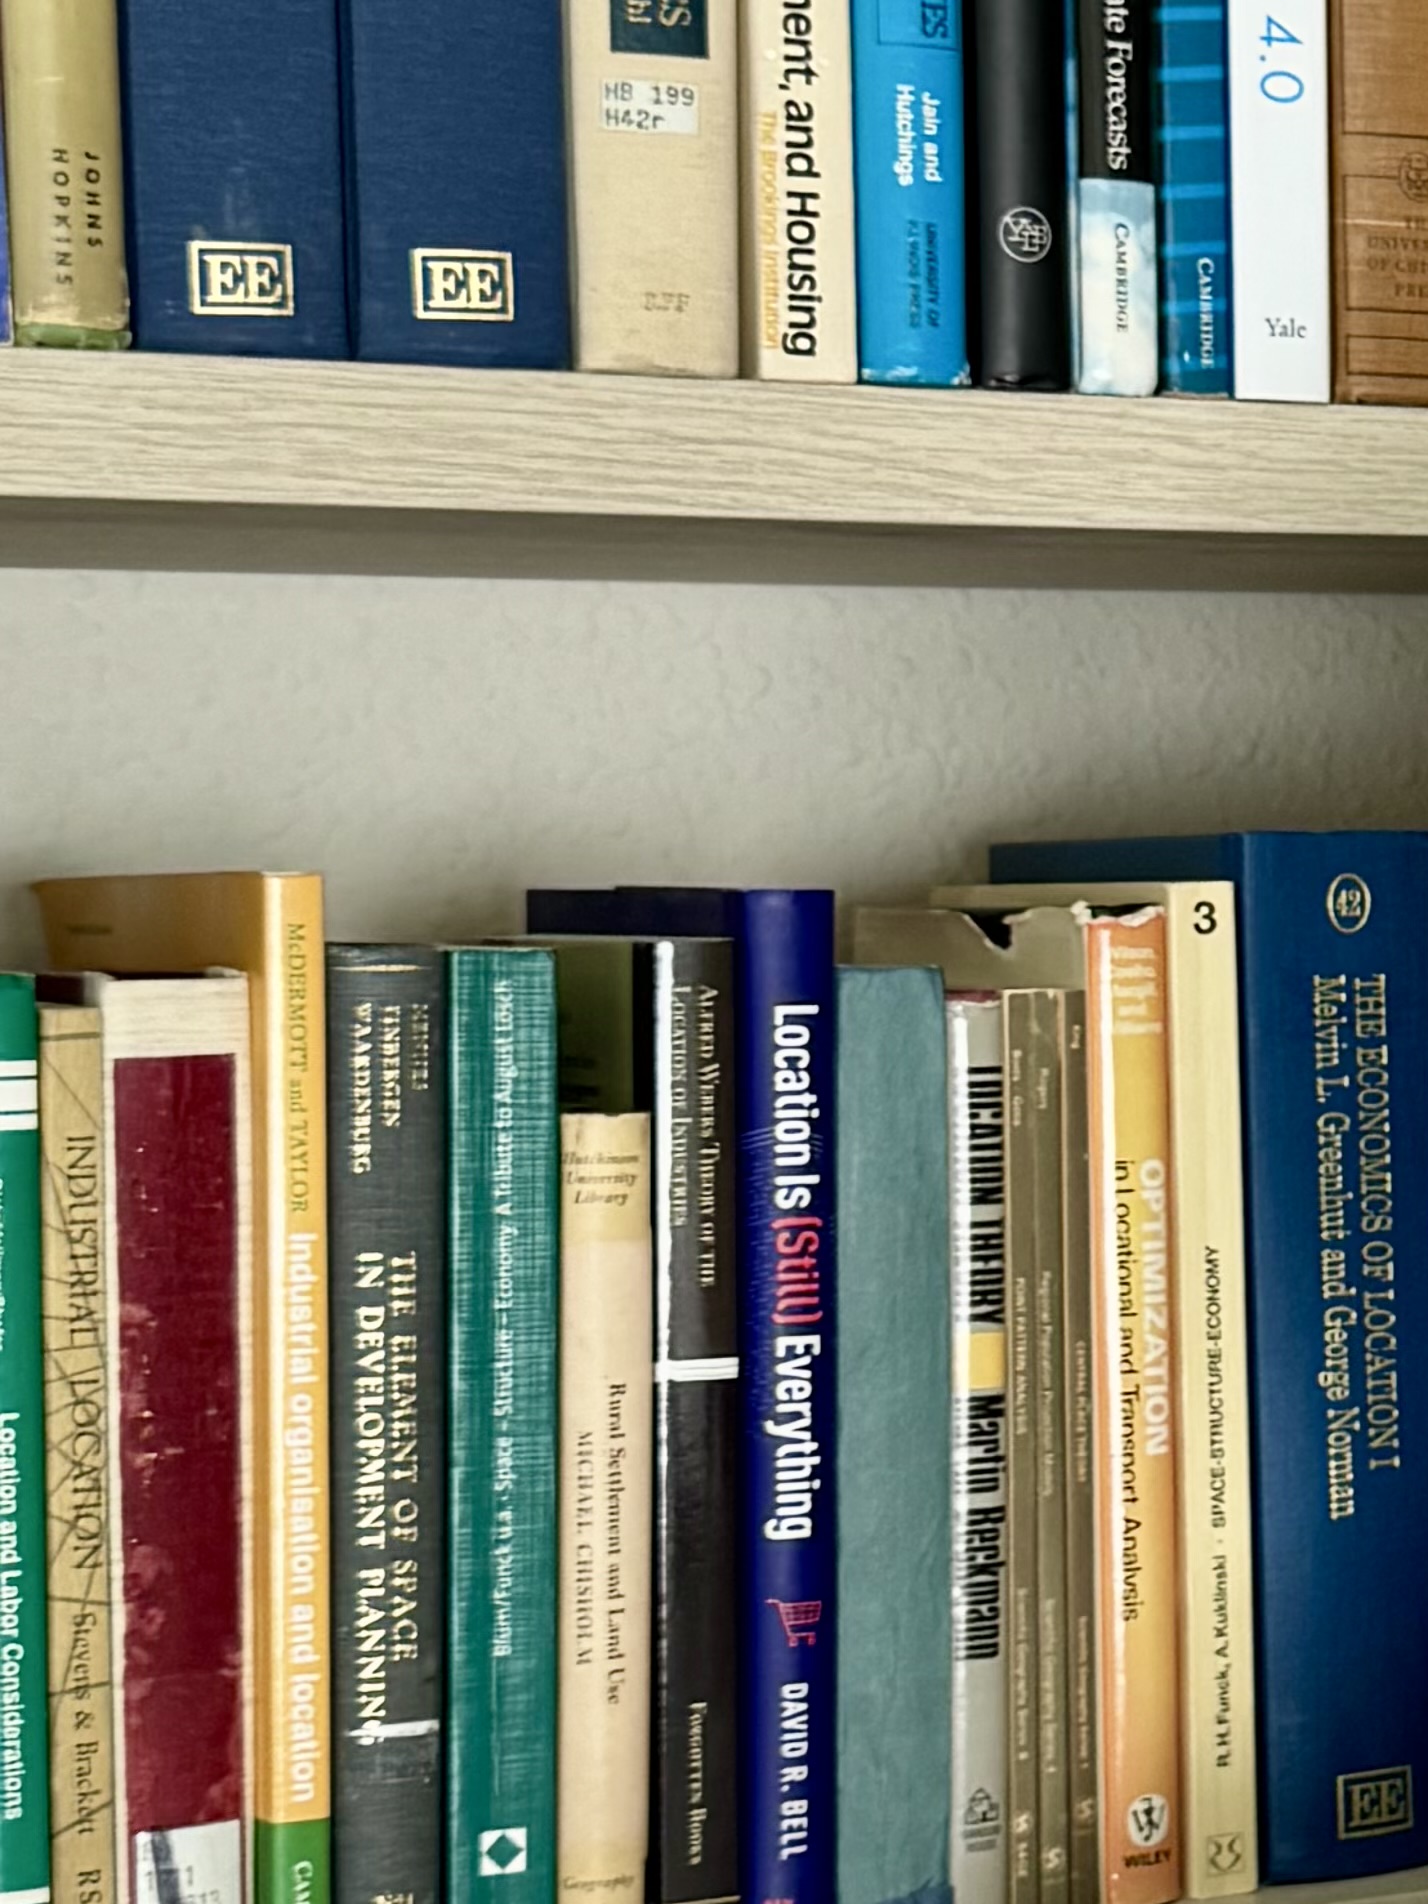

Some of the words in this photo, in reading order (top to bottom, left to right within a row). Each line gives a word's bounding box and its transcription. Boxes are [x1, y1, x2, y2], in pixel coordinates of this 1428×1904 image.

[1258, 15, 1304, 105] 4.0
[605, 83, 632, 102] HB
[652, 85, 694, 106] 199
[922, 92, 940, 136] Jain
[786, 102, 819, 178] and
[896, 84, 914, 186] Hutchings
[924, 141, 942, 182] and
[51, 149, 71, 285] HOPKINS
[86, 151, 102, 248] JOHNS
[203, 255, 282, 304] EE
[428, 262, 502, 308] EE
[782, 185, 821, 357] Housing
[1265, 317, 1307, 339] Yale
[1193, 902, 1217, 934] 3
[1334, 889, 1362, 916] 42
[774, 1004, 819, 1167] Location
[775, 1174, 819, 1210] Is
[770, 1216, 824, 1327] (Still)
[764, 1334, 822, 1541] Everything
[779, 1682, 809, 1766] DAVID
[780, 1773, 807, 1792] R.
[1346, 1780, 1405, 1828] EE
[779, 1801, 808, 1861] BELL
